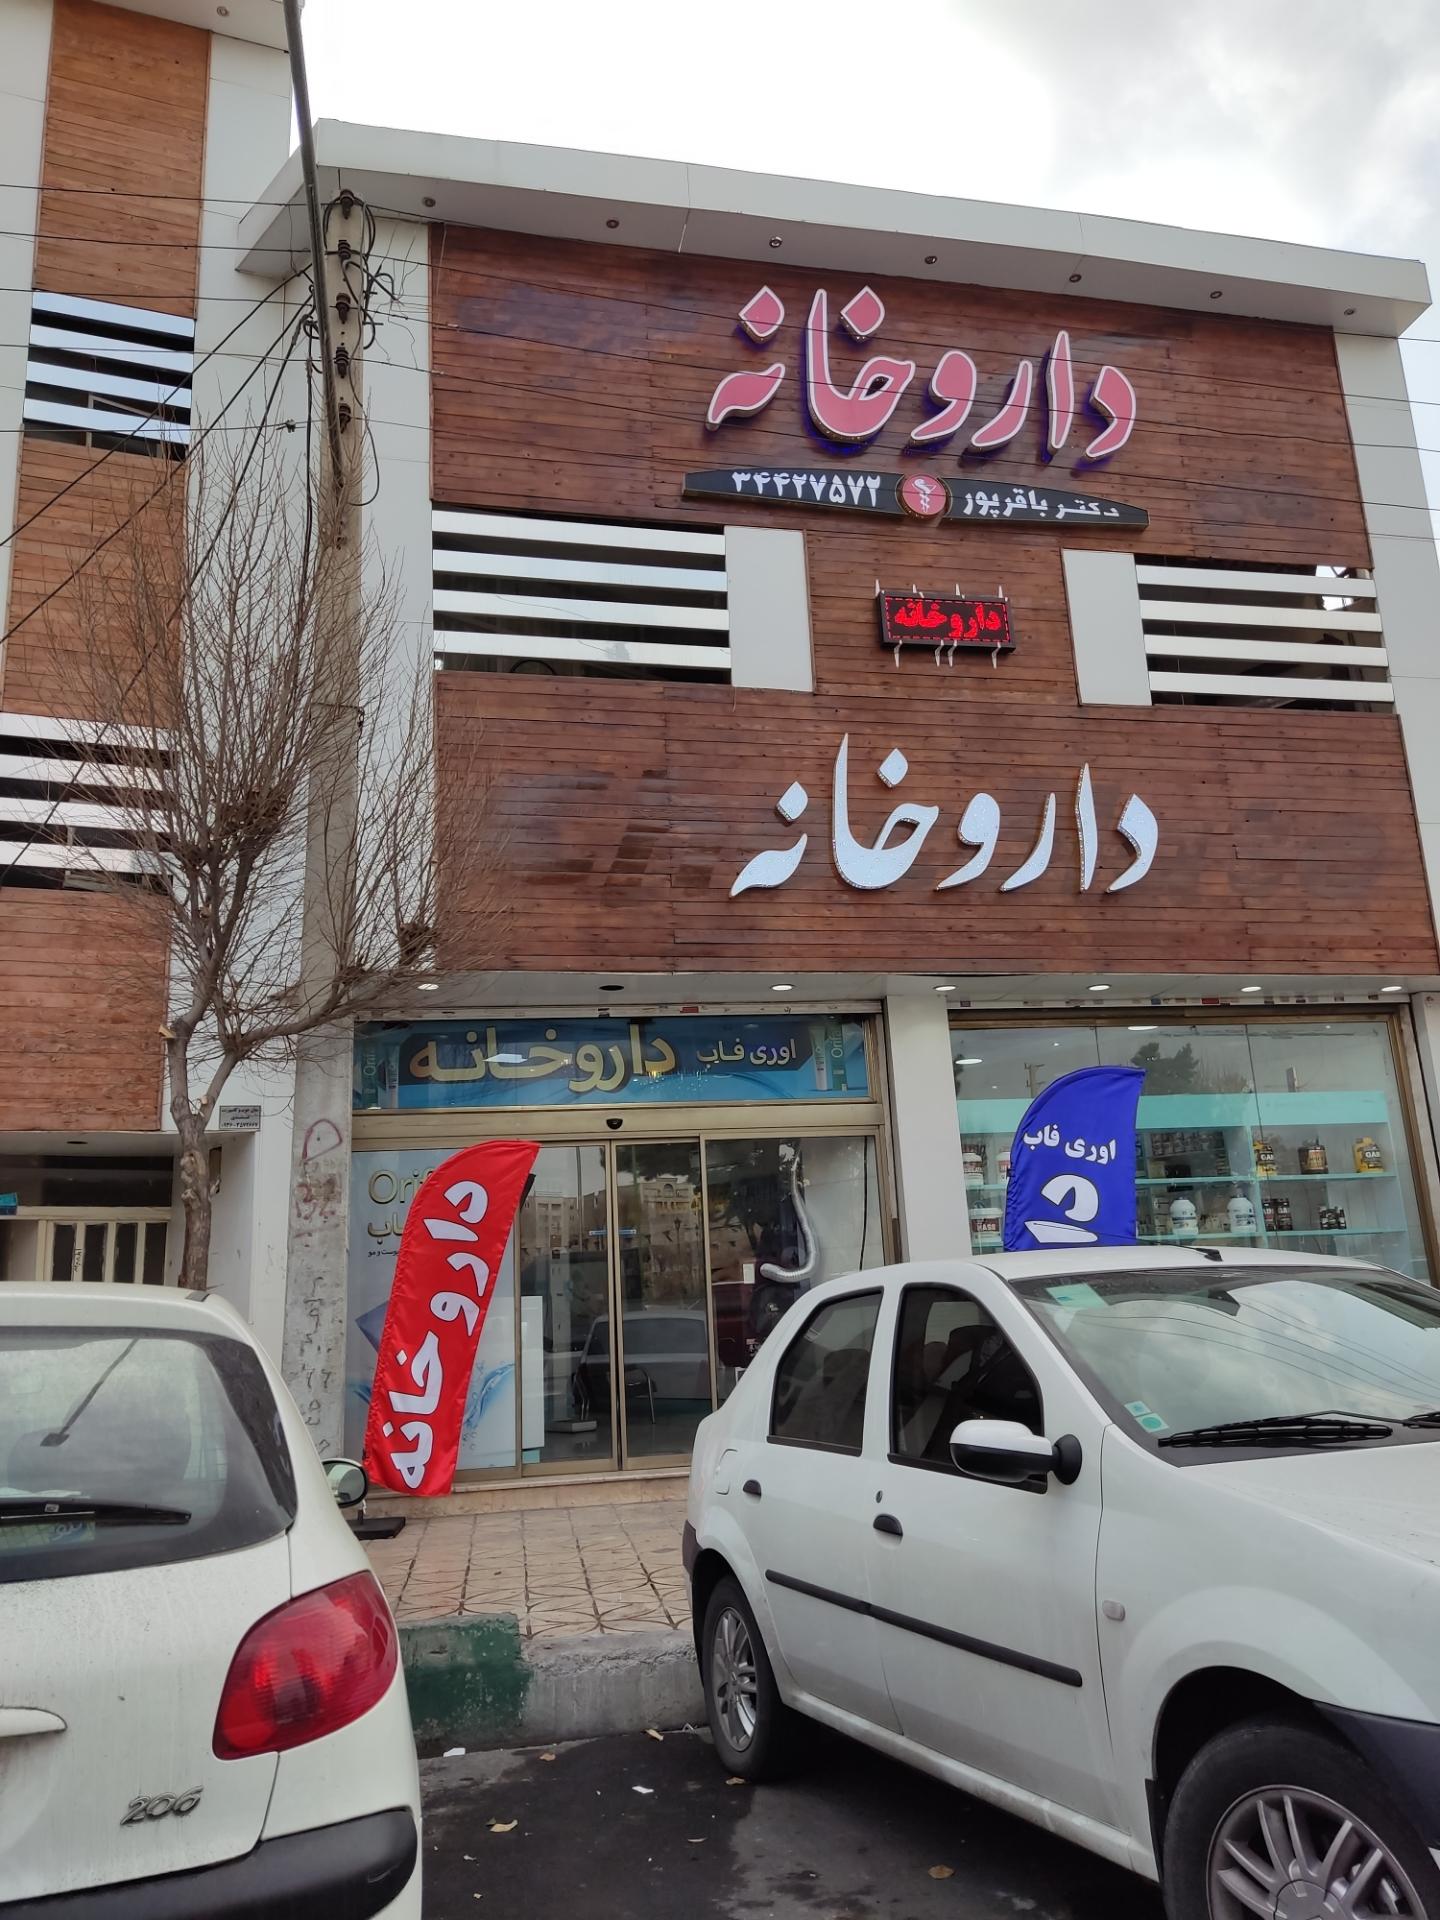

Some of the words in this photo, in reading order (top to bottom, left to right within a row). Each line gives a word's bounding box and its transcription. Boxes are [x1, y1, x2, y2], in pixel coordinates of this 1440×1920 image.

[962, 487, 1049, 518] باقرپور
[1055, 499, 1120, 519] دکتر
[409, 1023, 677, 1094] داروخانه
[696, 1038, 745, 1069] فاب
[749, 1038, 797, 1066] اوری
[1023, 1123, 1060, 1151] فاب
[1064, 1138, 1116, 1165] اوری
[120, 1785, 204, 1825] 206
